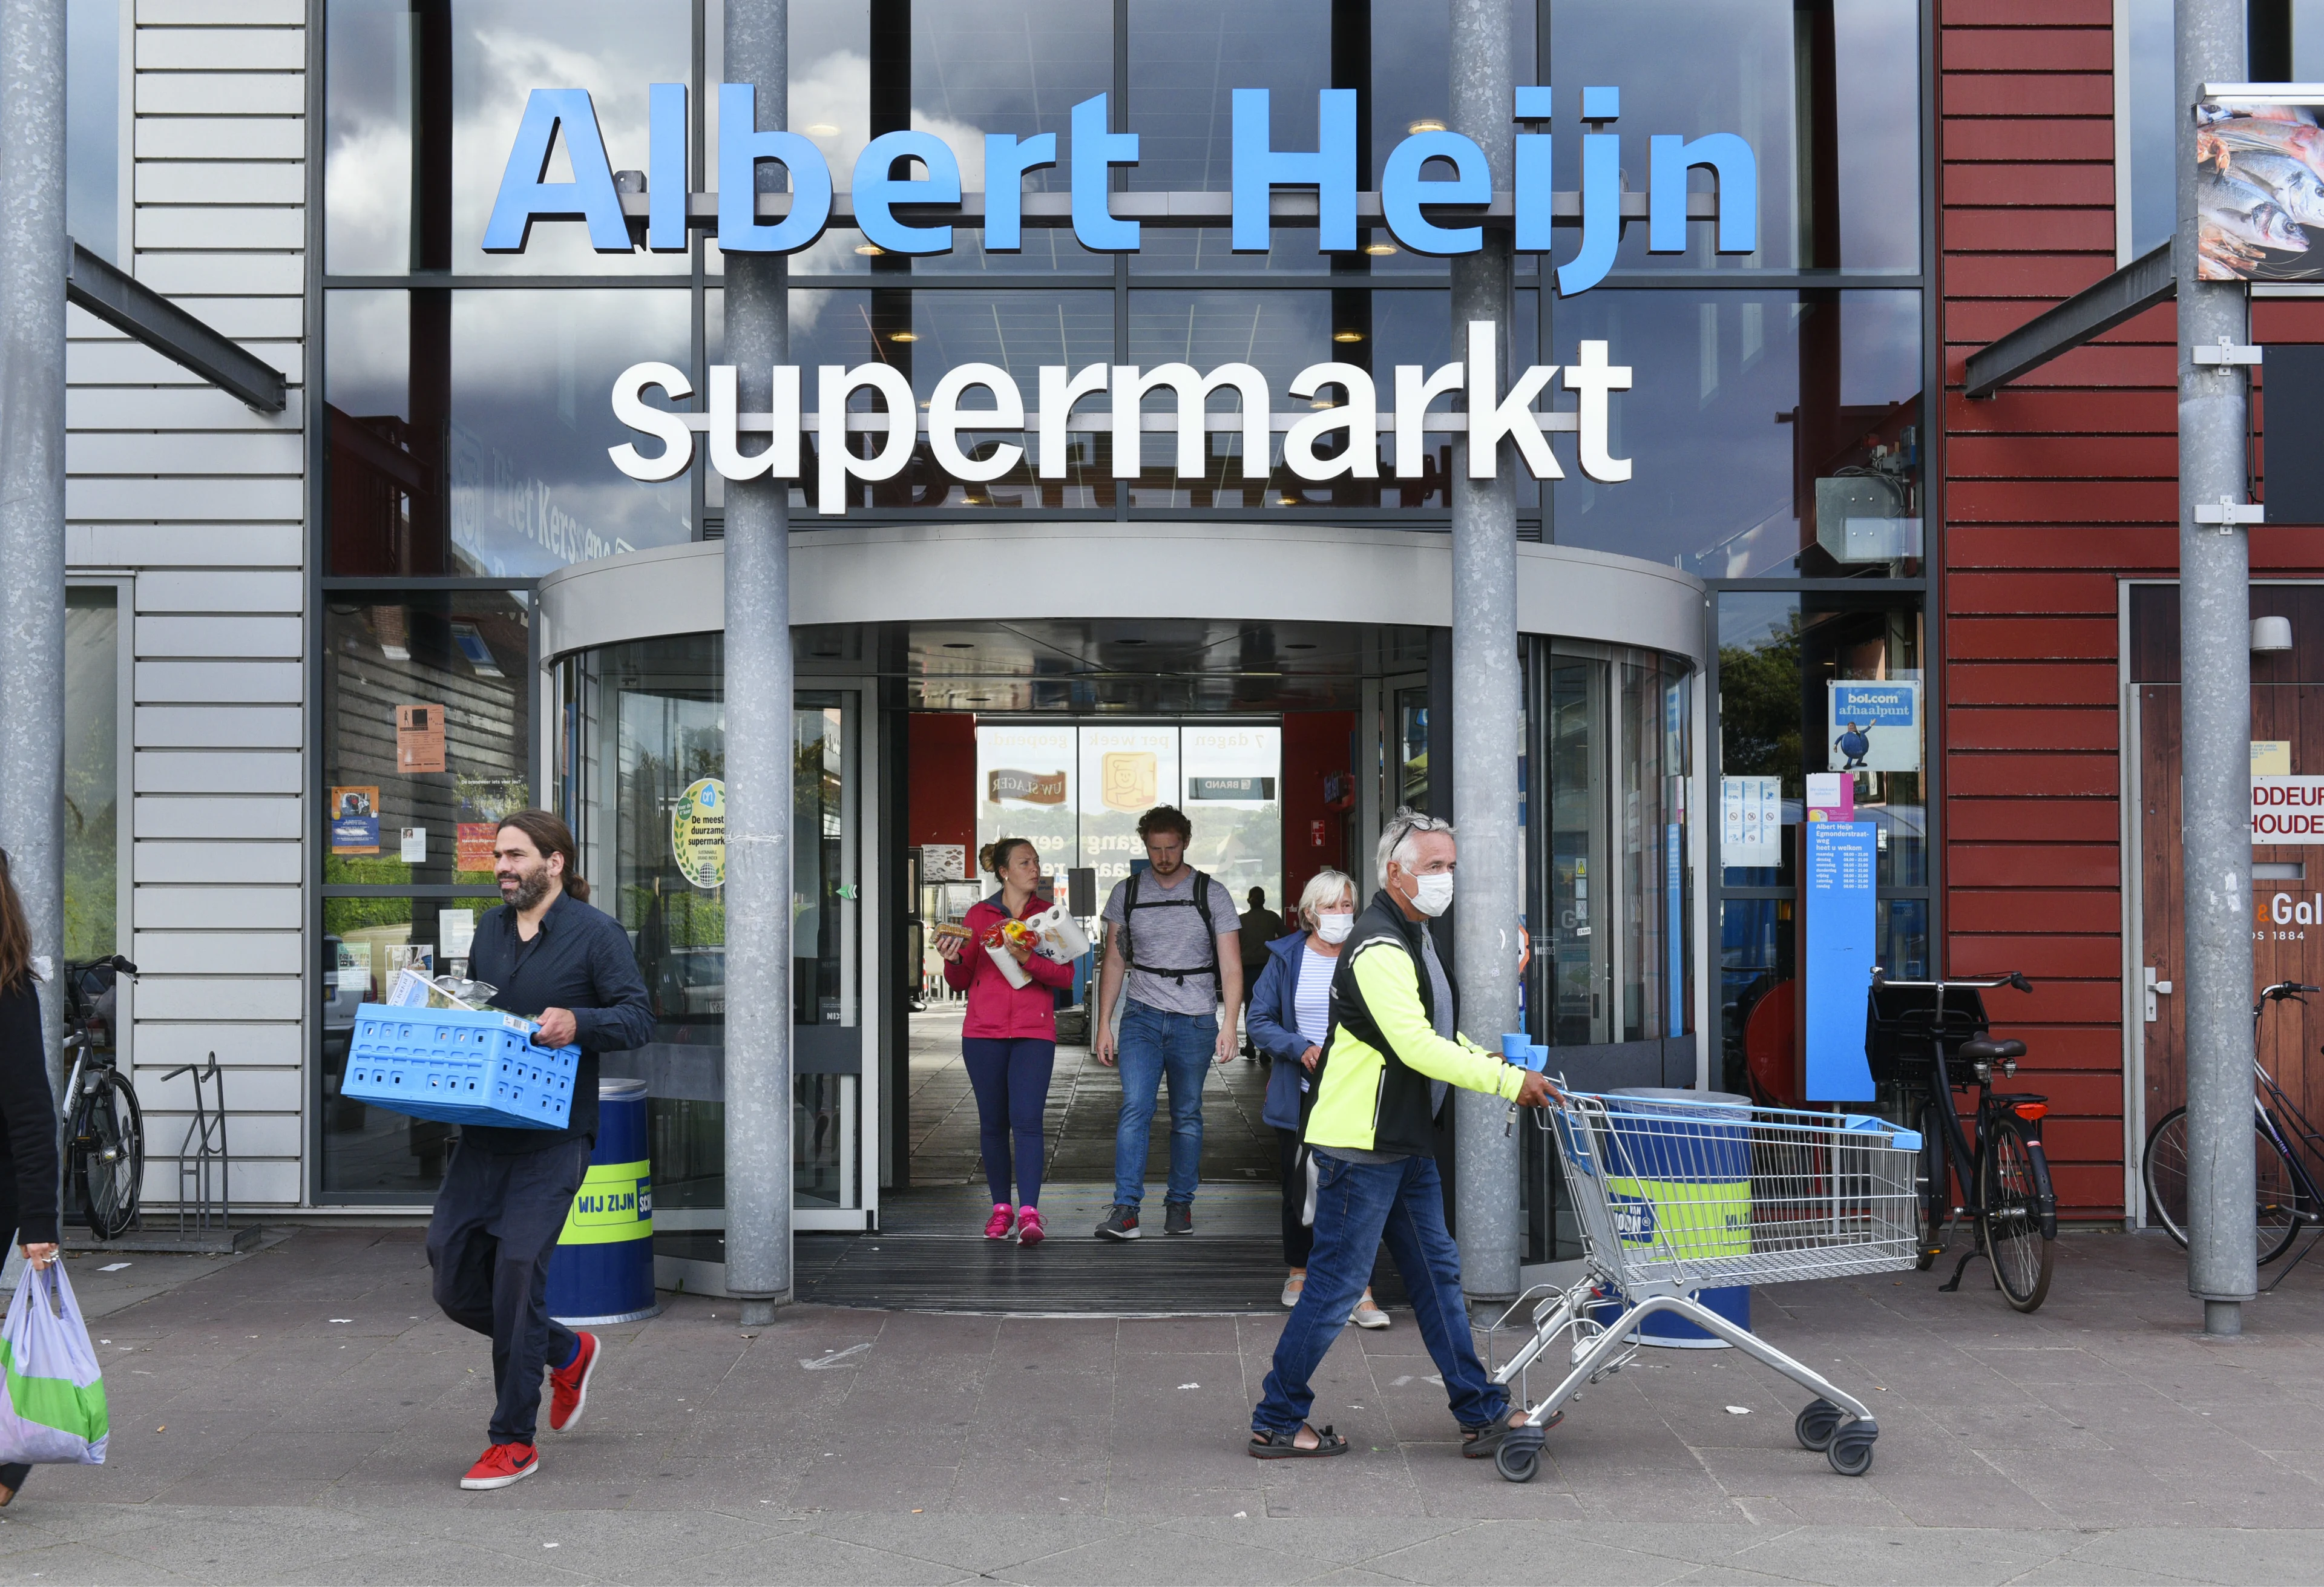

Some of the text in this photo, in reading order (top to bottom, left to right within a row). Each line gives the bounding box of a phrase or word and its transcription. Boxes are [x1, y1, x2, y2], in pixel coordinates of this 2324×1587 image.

[481, 83, 1757, 300] Albert Heijn
[607, 320, 1633, 515] supermarkt
[1848, 693, 1899, 704] bol.com
[1839, 705, 1909, 717] afhaalpunt
[2251, 787, 2324, 806] DDEU
[703, 815, 724, 824] meest
[691, 826, 725, 835] duurzame
[2257, 893, 2322, 925] & Gal
[2273, 931, 2305, 940] 1884
[70, 1077, 80, 1111] Gazelle
[578, 1195, 603, 1213] WIJ
[608, 1192, 635, 1212] ZIJN
[1629, 1205, 1641, 1215] VAN
